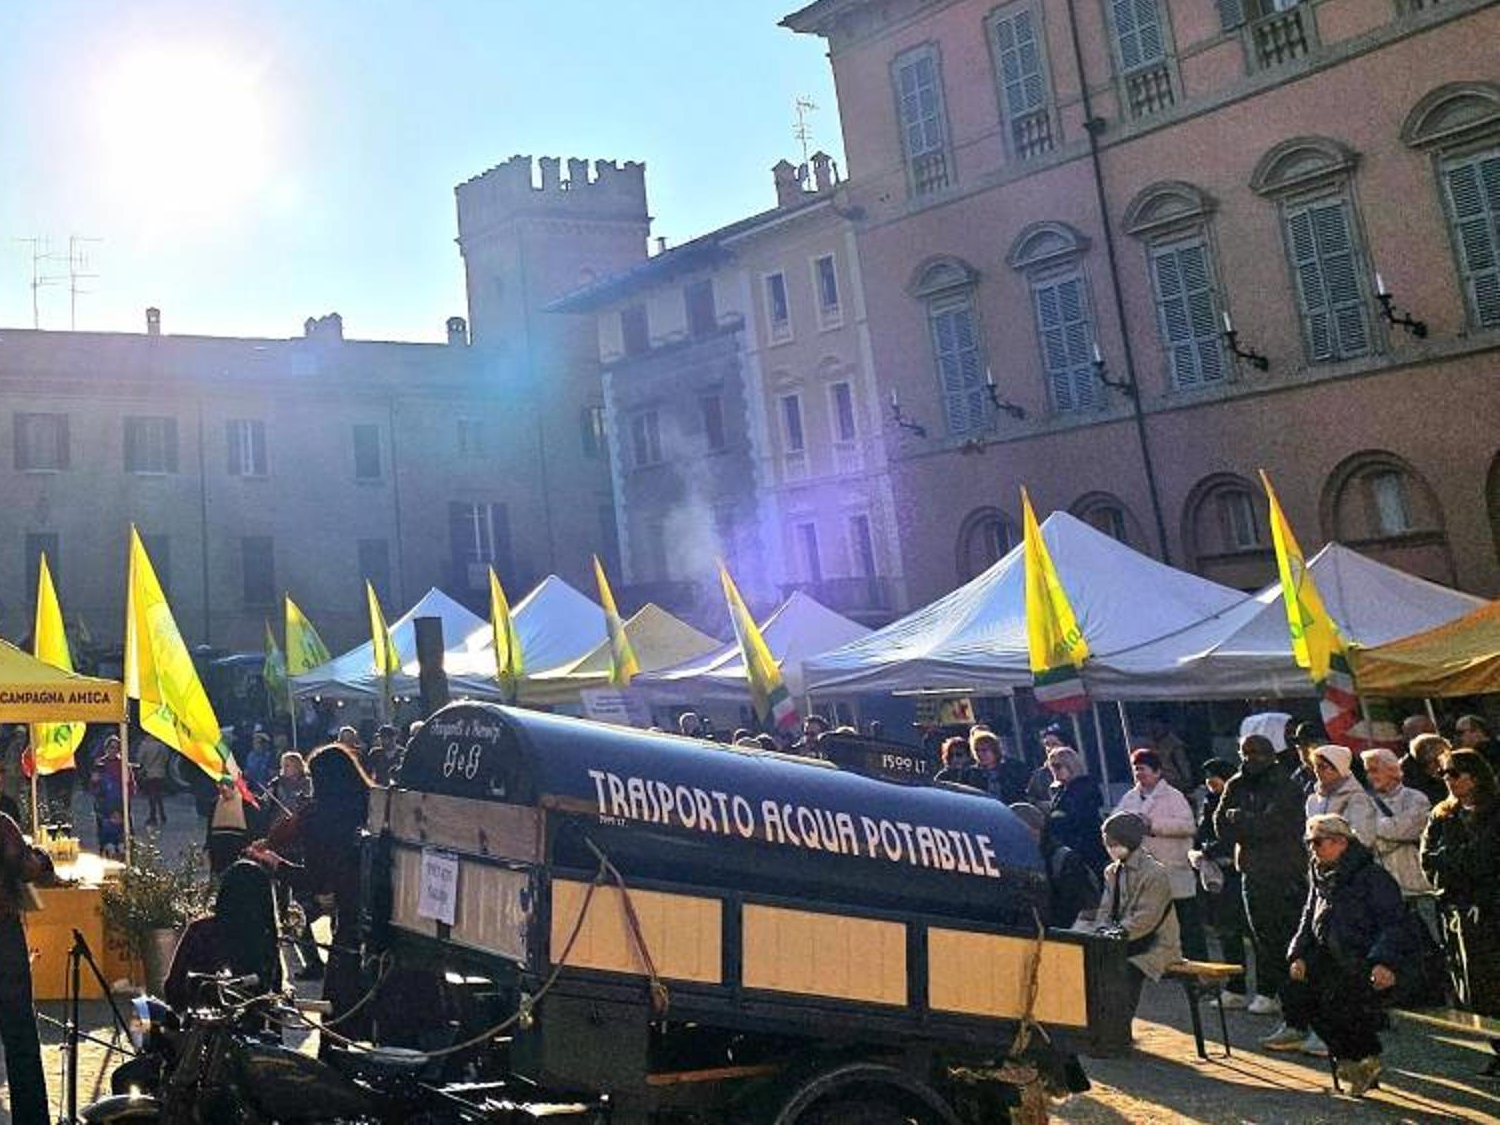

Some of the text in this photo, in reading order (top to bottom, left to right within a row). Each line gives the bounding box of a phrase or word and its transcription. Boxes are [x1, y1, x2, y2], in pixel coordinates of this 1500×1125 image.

[0, 690, 111, 704] CAMPAGNA AMICA
[588, 769, 1001, 878] TRASPORTO ACQUA POTABILE
